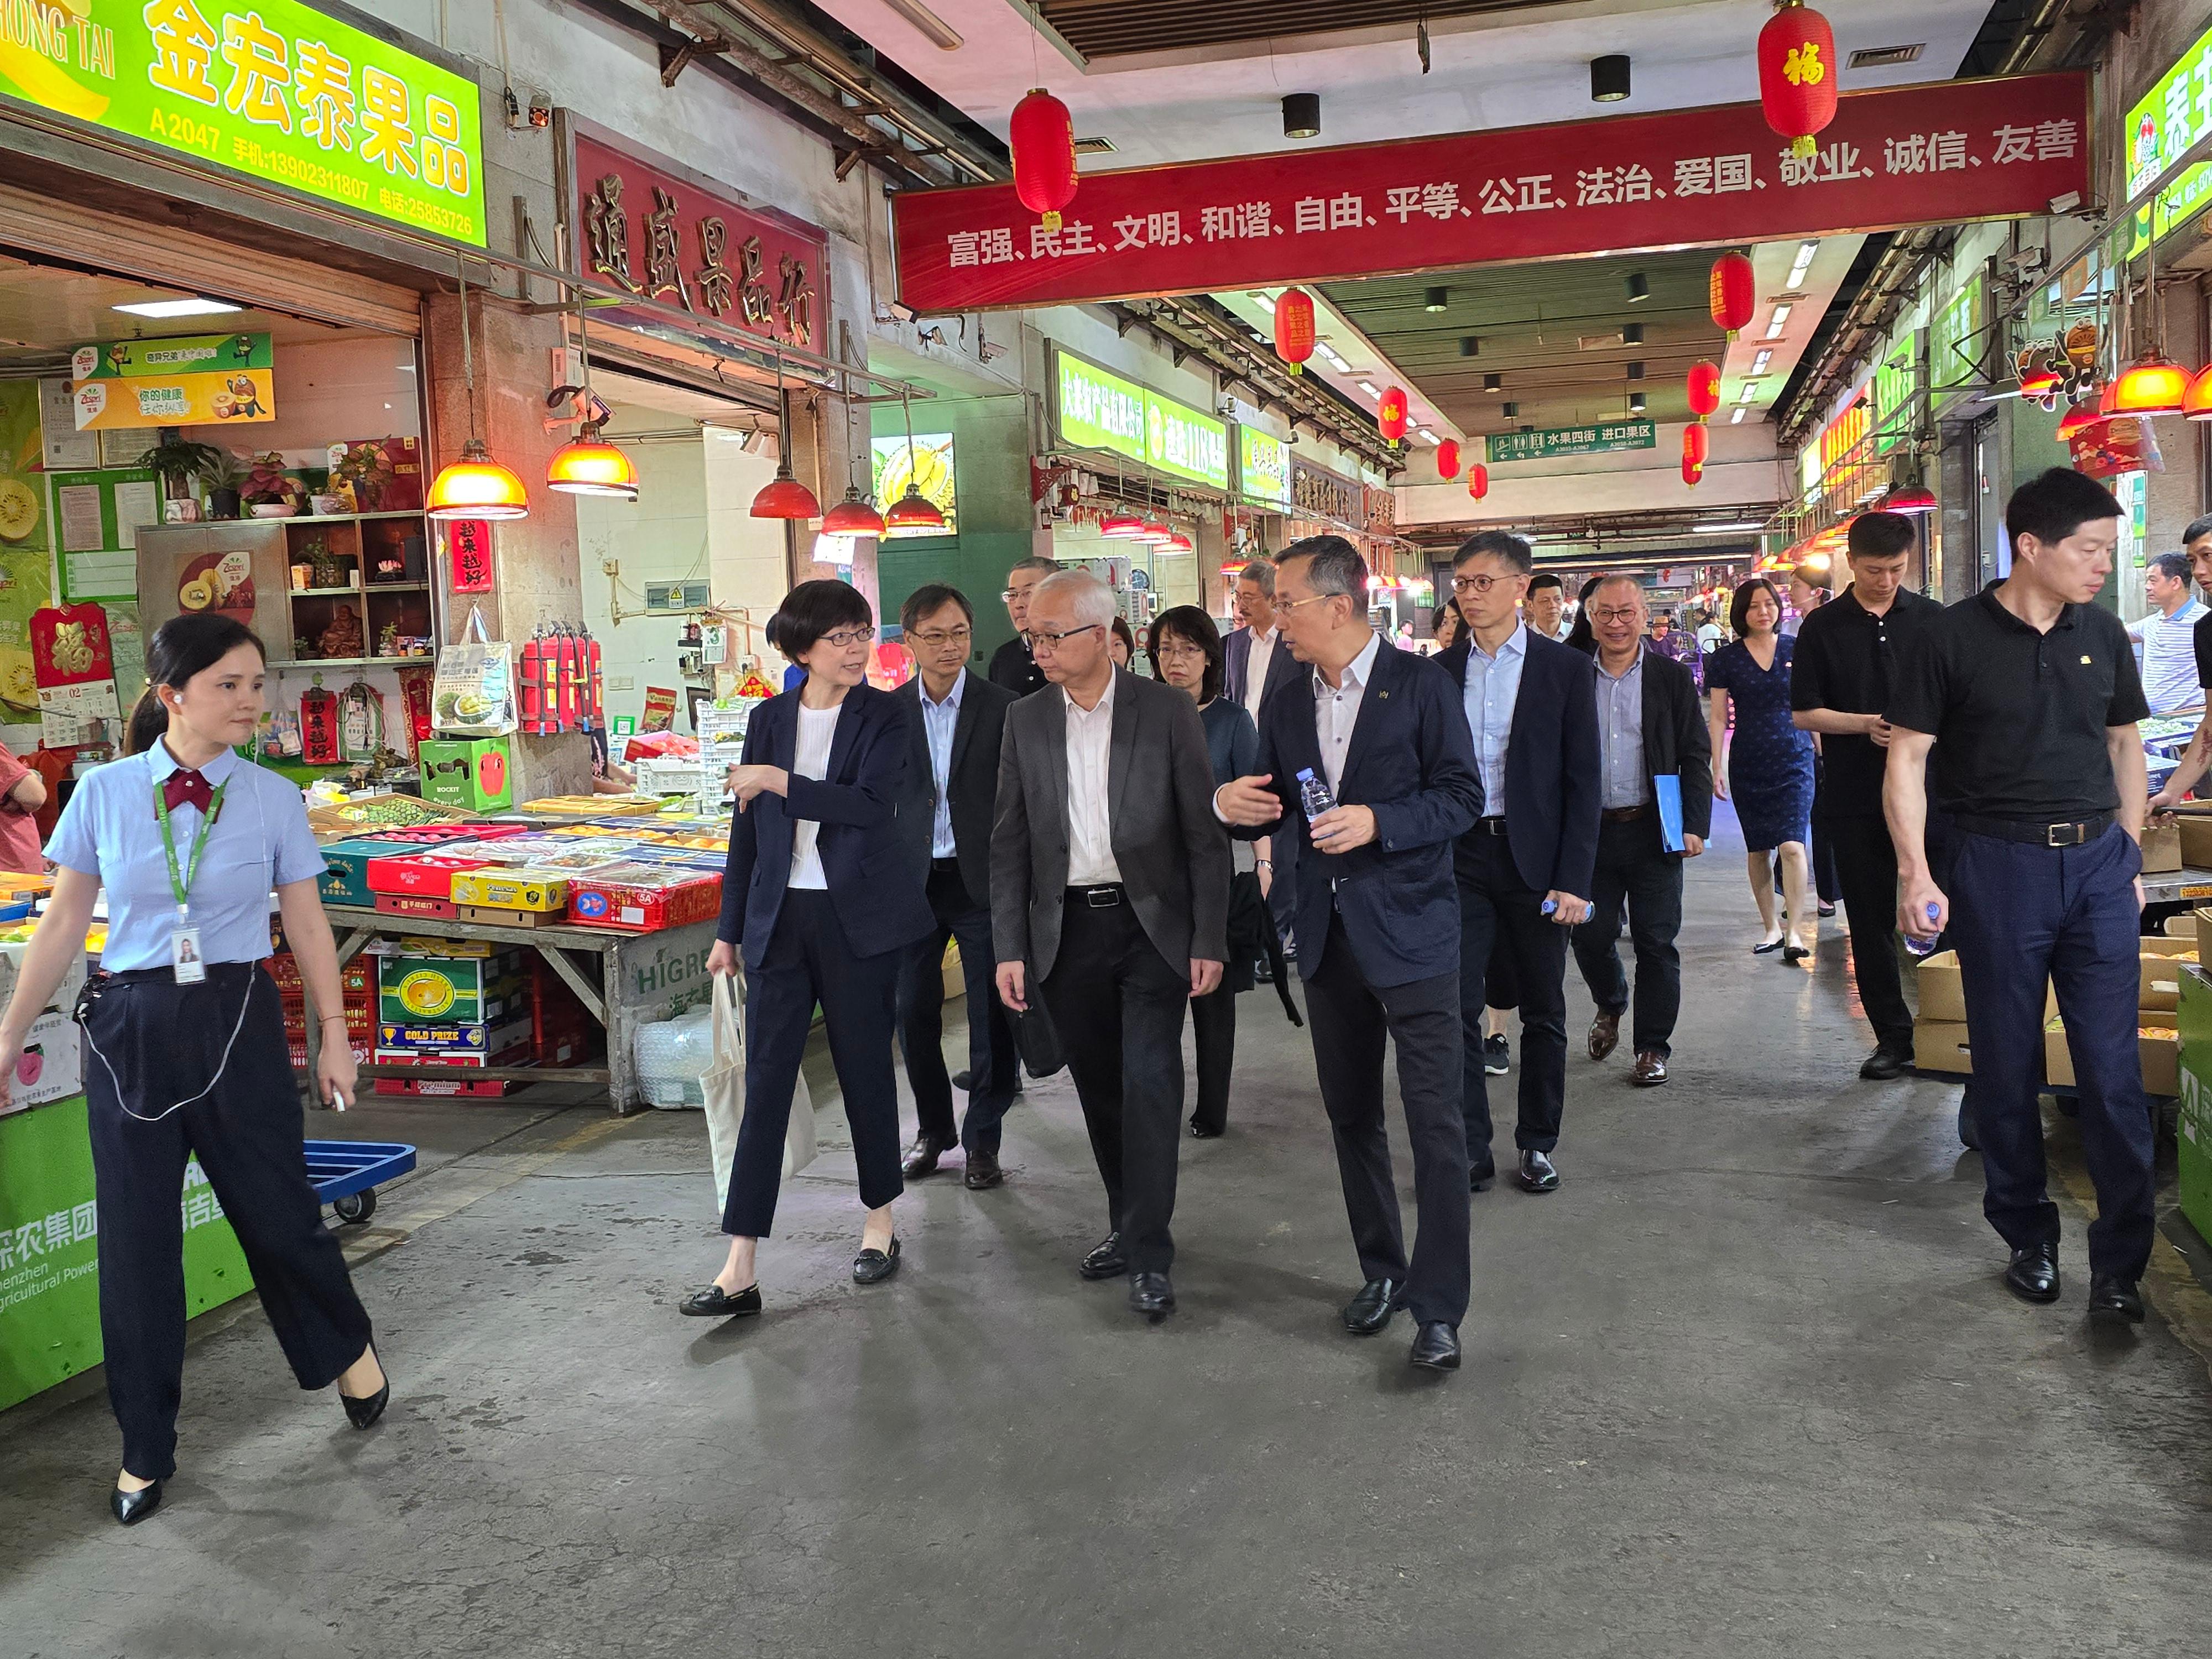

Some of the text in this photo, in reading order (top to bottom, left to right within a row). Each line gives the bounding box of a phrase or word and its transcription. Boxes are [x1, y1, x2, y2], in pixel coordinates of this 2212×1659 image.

[72, 15, 116, 80] TAI
[1783, 41, 1824, 86] 福
[143, 0, 470, 197] 金宏泰果品
[150, 107, 473, 237] A2047 手机:13902311807 电话:25853726
[139, 388, 183, 402] 你的健康
[1548, 425, 1651, 445] 水果四街 进口果区
[458, 520, 488, 585] 越来越好
[70, 687, 81, 698] 02
[452, 796, 465, 806] day
[640, 894, 652, 902] 5A
[351, 977, 363, 987] 5A
[405, 1031, 459, 1040] GOLD PRIZE
[418, 1080, 461, 1089] Premium
